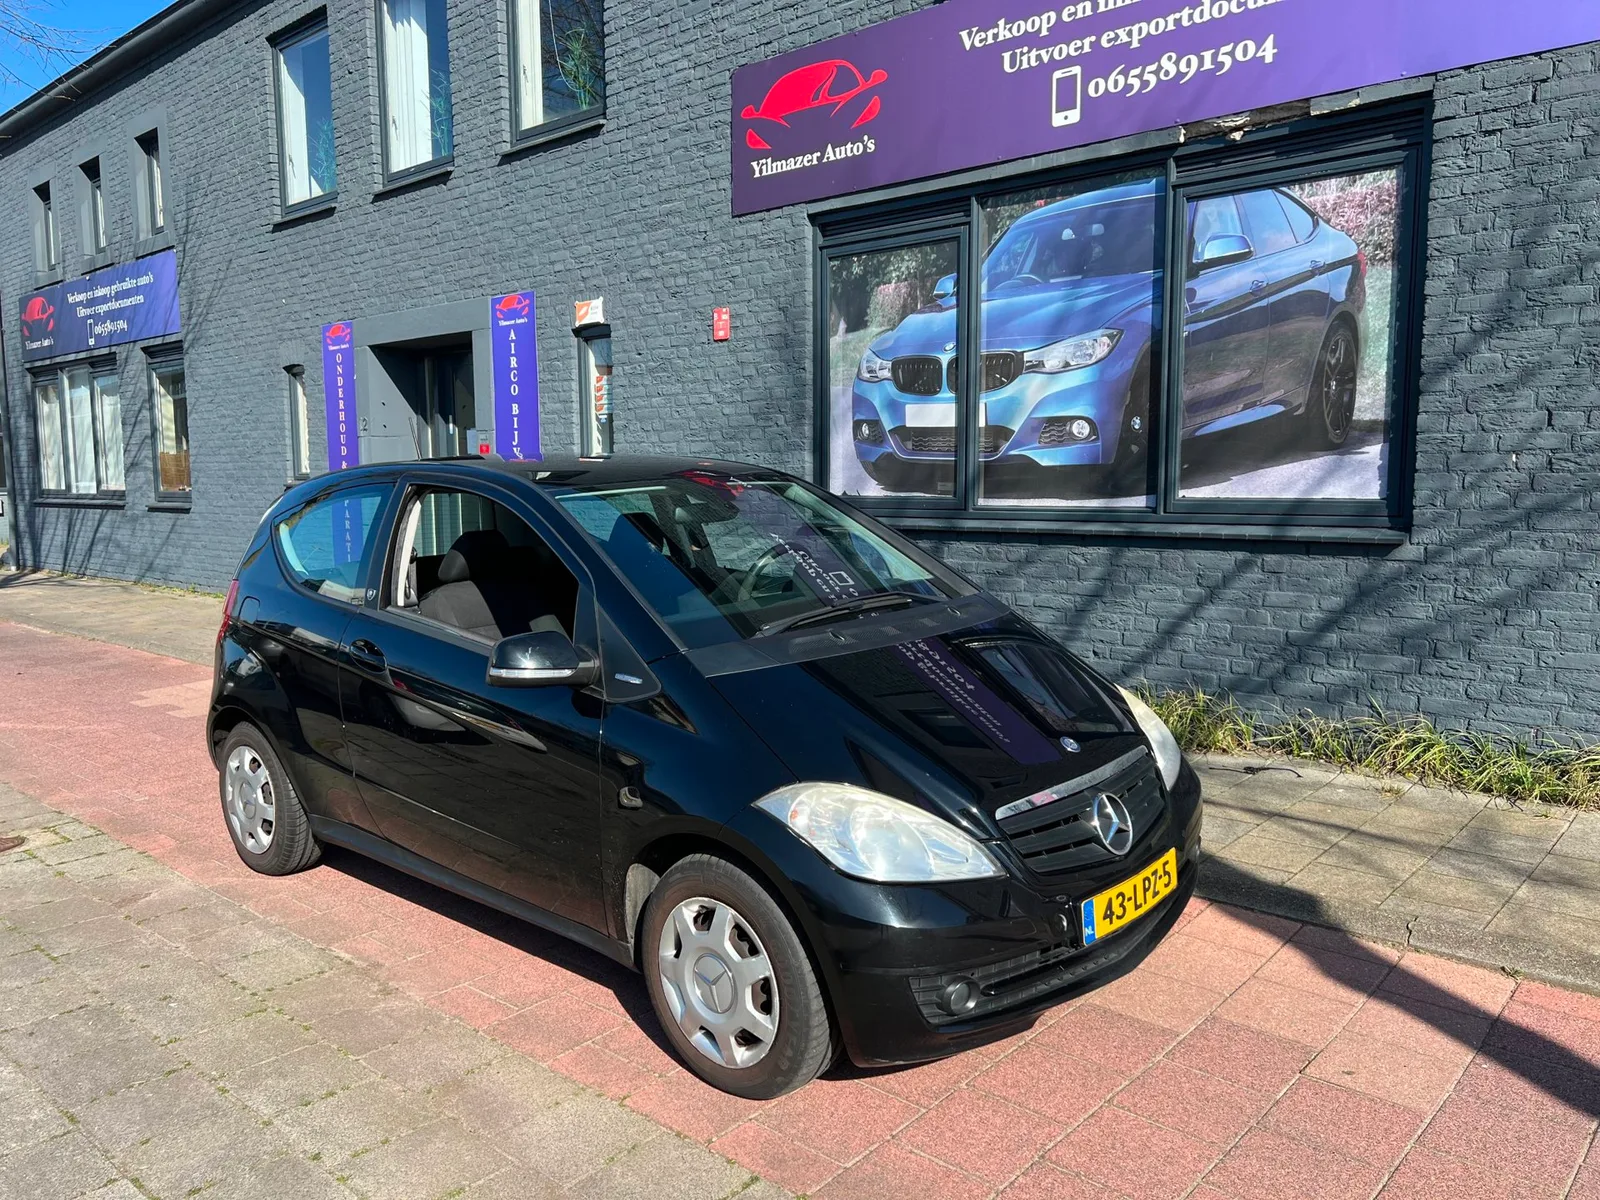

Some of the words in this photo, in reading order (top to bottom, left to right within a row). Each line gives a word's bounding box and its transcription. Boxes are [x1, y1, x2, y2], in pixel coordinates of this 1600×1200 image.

[959, 11, 1057, 51] Verkoop
[1061, 2, 1094, 23] en
[1001, 35, 1097, 73] Uitvoer
[1100, 0, 1283, 48] exportdocu
[1087, 33, 1278, 98] 0655891504
[750, 151, 821, 178] Yilmazer
[822, 134, 876, 162] Auto's
[67, 291, 87, 304] Verkoop
[87, 290, 94, 299] en
[93, 285, 111, 297] inkoop
[111, 277, 137, 296] gebruikte
[76, 306, 95, 317] Uitvoer
[95, 294, 145, 315] exportdocumenten
[94, 319, 128, 336] 0655891504
[508, 328, 519, 396] AIRCO
[335, 352, 347, 456] ONDERHOUD
[341, 460, 348, 470] &
[1102, 860, 1172, 926] 43-LPZ-5
[1085, 925, 1094, 937] NL
